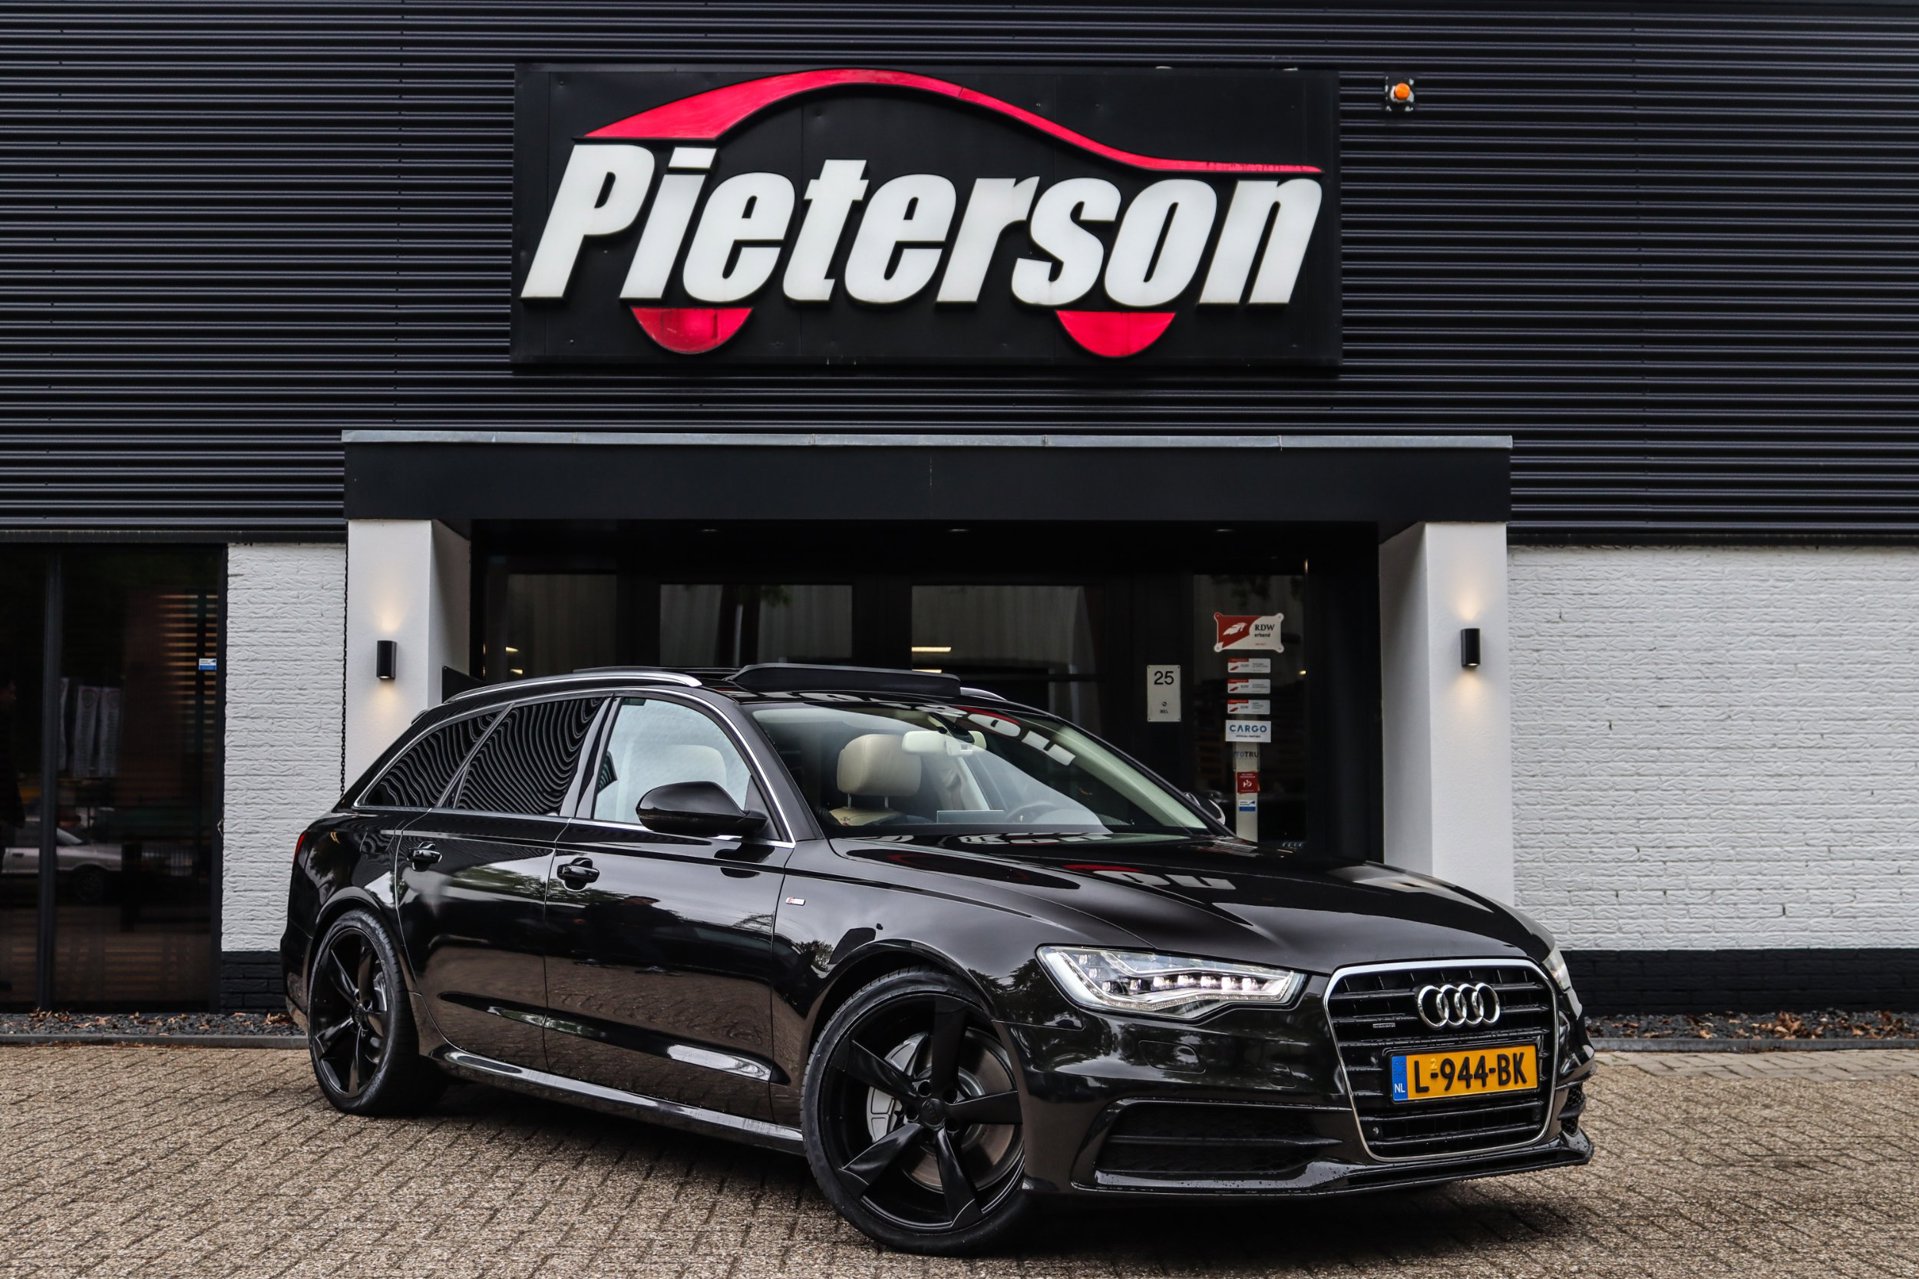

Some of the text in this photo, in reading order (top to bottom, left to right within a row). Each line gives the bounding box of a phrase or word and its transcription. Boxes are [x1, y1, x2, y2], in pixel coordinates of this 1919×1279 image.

[520, 143, 1323, 308] Pieterson
[1254, 623, 1275, 631] RDW
[1154, 670, 1174, 685] 25
[1229, 724, 1267, 733] CARGO
[1414, 1052, 1527, 1093] L-944-BK
[1394, 1083, 1405, 1093] NL
